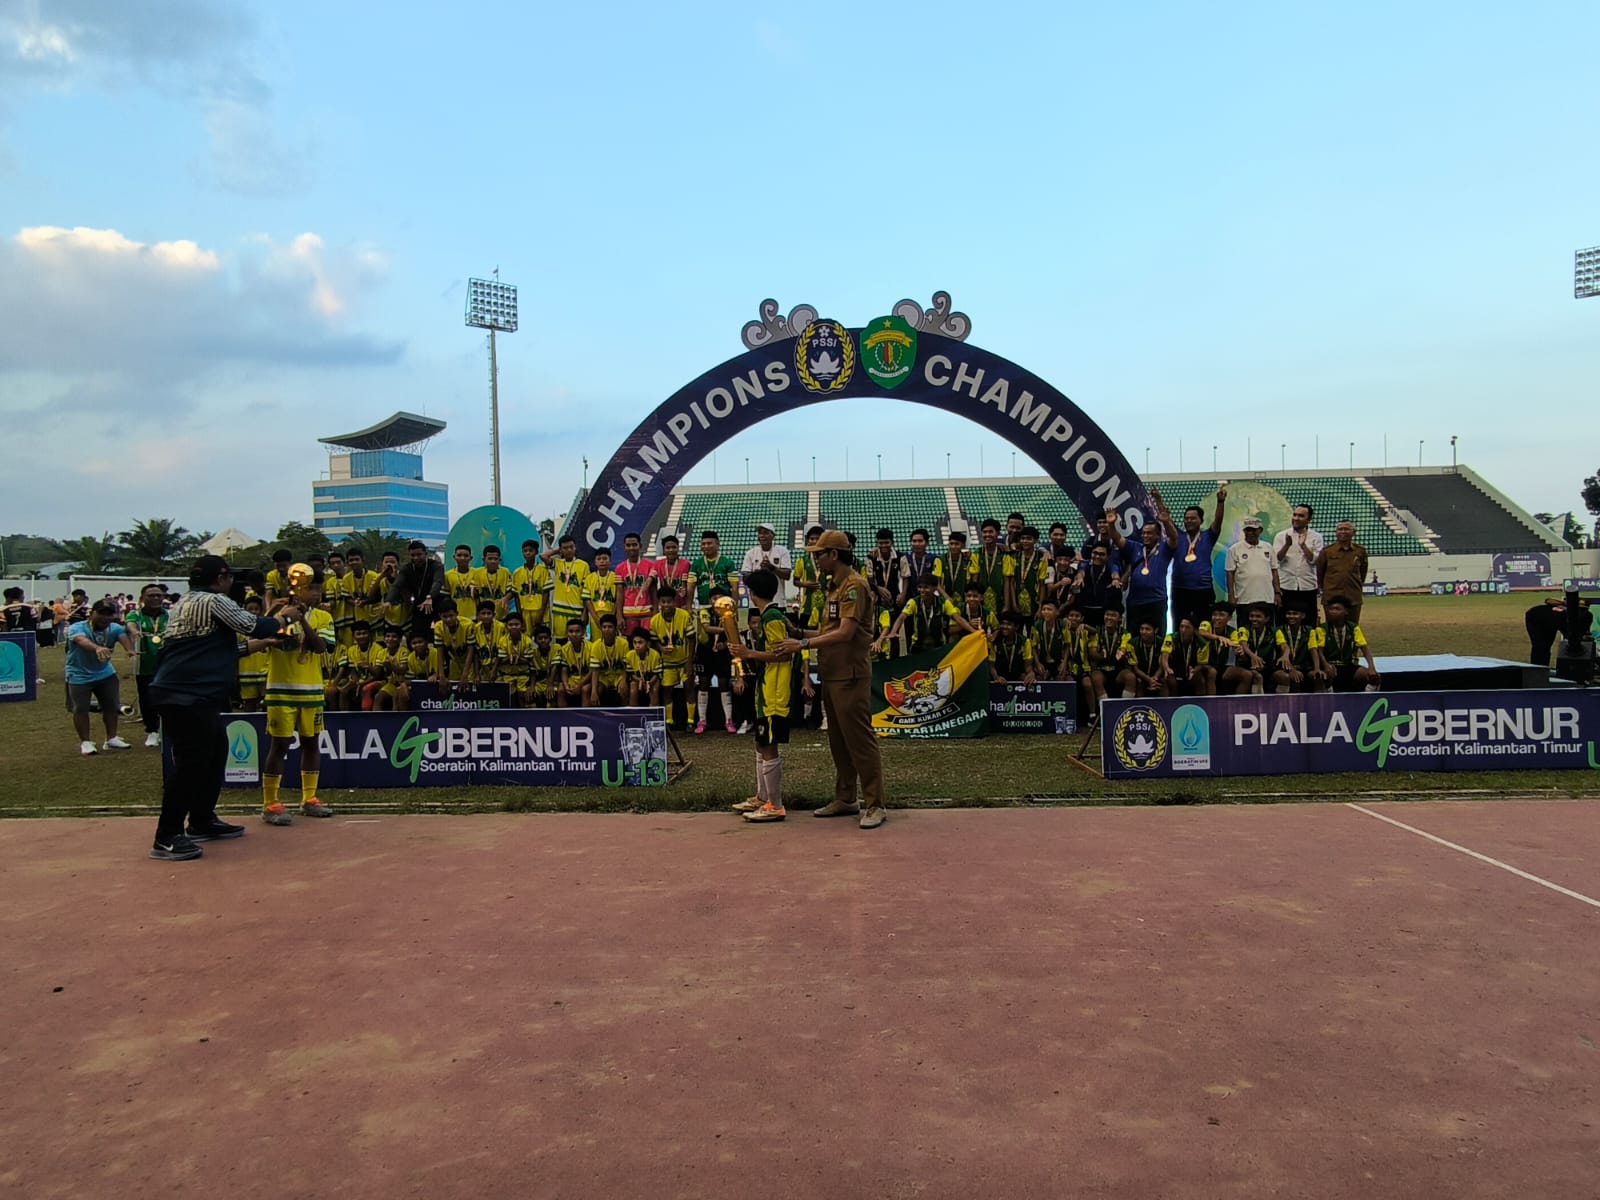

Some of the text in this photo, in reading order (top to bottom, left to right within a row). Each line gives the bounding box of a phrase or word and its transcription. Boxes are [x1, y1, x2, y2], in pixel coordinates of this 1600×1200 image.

[812, 337, 837, 348] PSSI
[585, 361, 791, 550] CHAMPIONS
[924, 354, 1144, 538] CHAMPIONS
[989, 694, 1041, 715] hampion
[903, 709, 988, 735] KARTANEGARA
[1128, 722, 1151, 732] PSSI
[1234, 697, 1580, 769] PIALA GUBERNUR
[283, 715, 595, 784] PALA GUBERNUR
[1388, 740, 1583, 756] Soeratin Kalimantan Timur
[419, 759, 597, 772] Soeratin Kalimantan Timur
[601, 759, 666, 788] U-13
